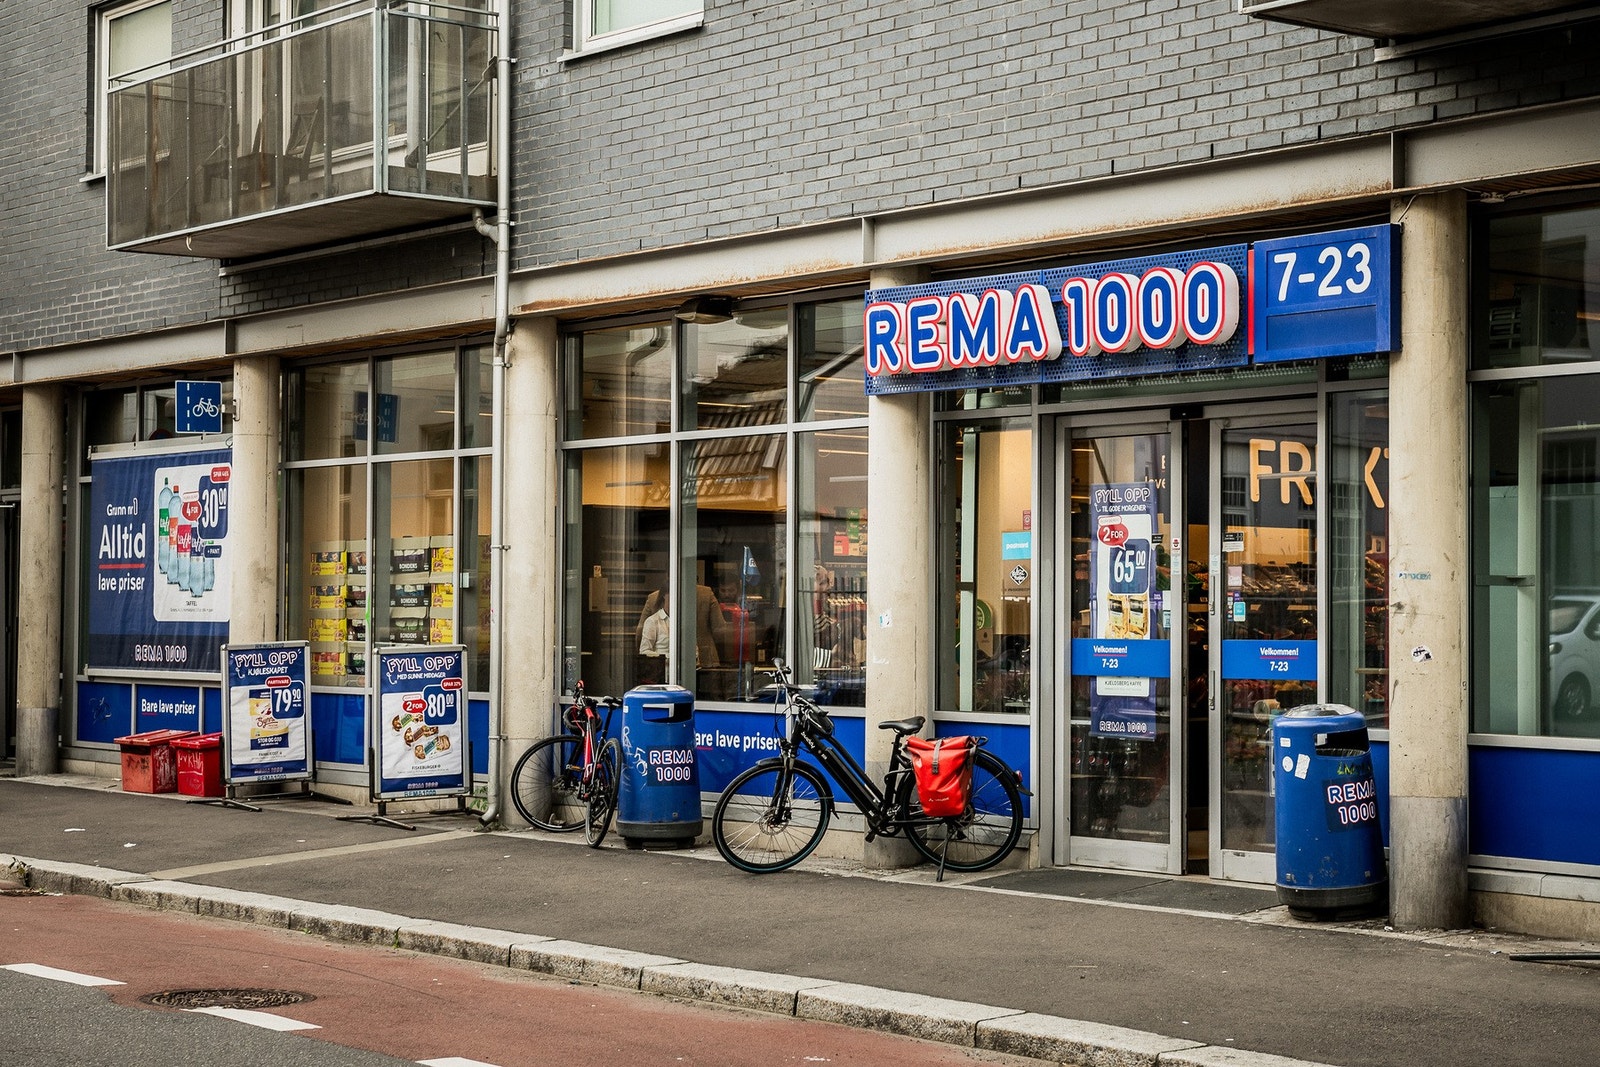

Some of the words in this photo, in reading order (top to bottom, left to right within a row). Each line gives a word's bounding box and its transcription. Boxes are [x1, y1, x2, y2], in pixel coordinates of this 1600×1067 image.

[1273, 242, 1373, 302] 7-23
[864, 283, 1053, 377] REMA
[1061, 261, 1226, 357] 1000
[1249, 438, 1389, 509] FRK
[1095, 488, 1122, 504] FYLL
[1124, 487, 1150, 502] OPP
[1122, 504, 1147, 512] MORGENER
[98, 522, 146, 560] Alltid
[1102, 526, 1110, 542] 2
[1110, 530, 1124, 538] FOR
[98, 572, 117, 591] lave
[118, 572, 146, 594] priser
[134, 644, 164, 662] REMA
[1093, 645, 1128, 654] Velkommen!
[1260, 647, 1299, 656] Velkommen!
[234, 654, 266, 668] FYLL
[268, 651, 298, 666] OPP
[387, 658, 422, 672] FYLL
[424, 656, 455, 671] OPP
[1102, 658, 1119, 669] 7-23
[1270, 660, 1289, 672] 7-23
[141, 698, 158, 713] Bare
[158, 700, 174, 714] lave
[174, 700, 196, 716] priser
[406, 701, 412, 711] 2
[1099, 720, 1126, 732] REMA
[1126, 721, 1148, 734] 1000
[694, 732, 713, 747] are
[716, 730, 740, 748] lave
[743, 732, 782, 752] priser
[650, 749, 694, 765] REMA
[656, 766, 691, 782] 1000
[1327, 779, 1375, 804] REMA
[1338, 801, 1376, 825] 1000
